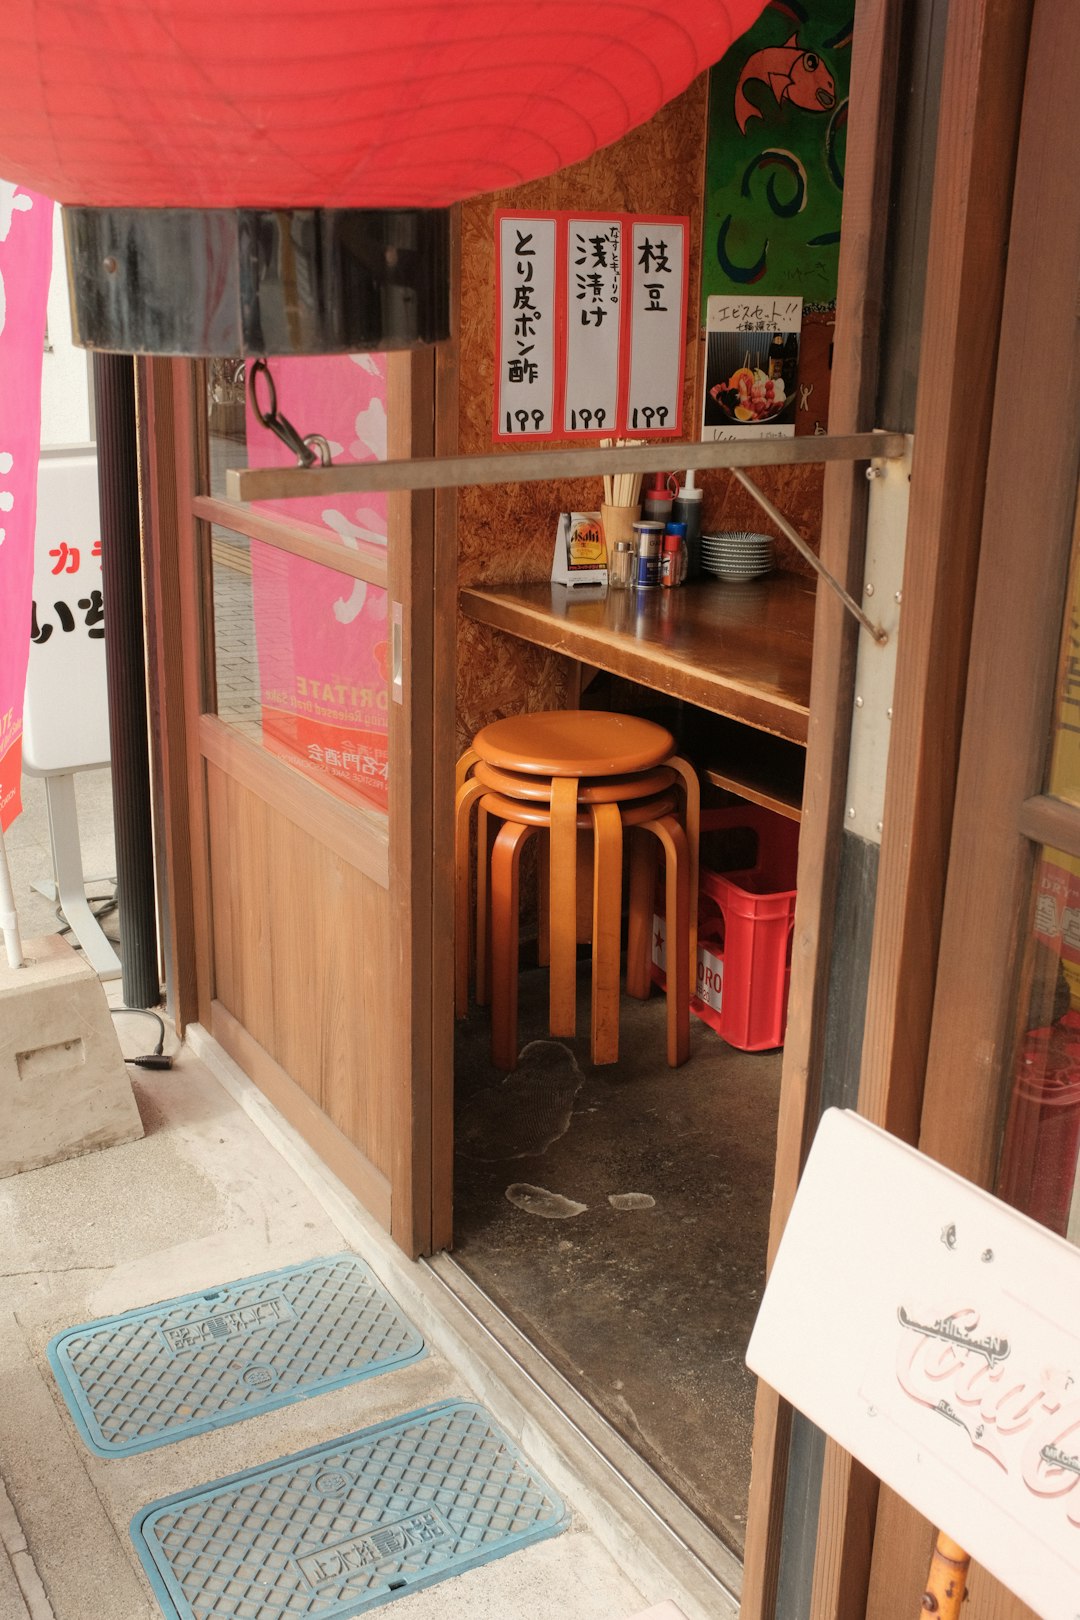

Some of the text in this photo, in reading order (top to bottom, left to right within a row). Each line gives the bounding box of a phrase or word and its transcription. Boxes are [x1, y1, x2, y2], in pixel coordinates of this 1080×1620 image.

[575, 234, 609, 327] 浅漬け
[637, 237, 672, 311] 枝豆
[507, 229, 541, 384] とり皮ポン酢
[506, 409, 544, 433] 199
[572, 408, 606, 430] 199
[632, 406, 669, 429] 199
[570, 529, 599, 543] Asahi
